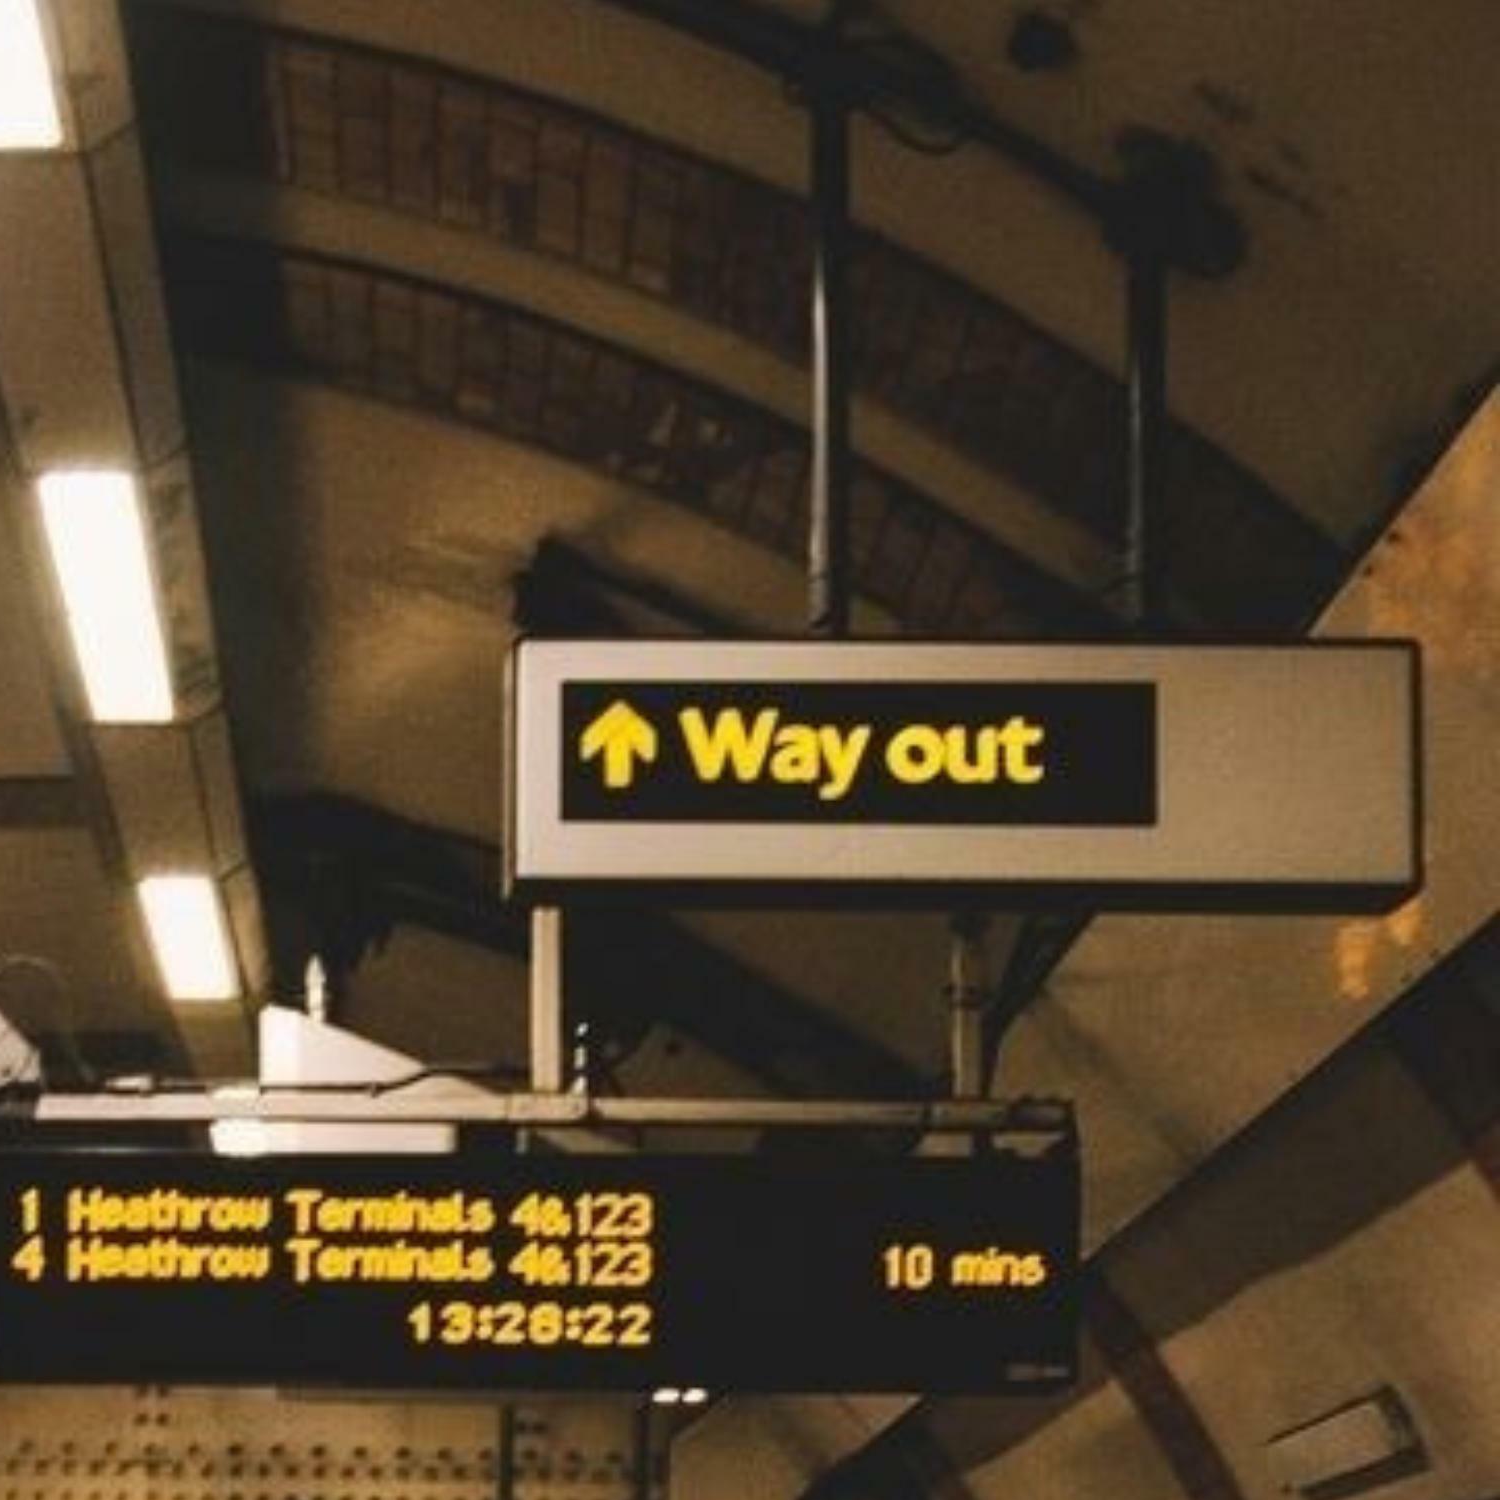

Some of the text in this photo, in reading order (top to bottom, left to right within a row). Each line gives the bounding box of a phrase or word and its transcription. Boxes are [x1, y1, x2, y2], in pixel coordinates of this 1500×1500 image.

[678, 707, 1045, 800] Way out
[21, 1187, 40, 1233] 1
[66, 1187, 273, 1233] Heathrow
[284, 1188, 496, 1234] Terminals
[11, 1235, 46, 1281] 4
[66, 1236, 272, 1281] Heathrow
[285, 1237, 496, 1283] Terminals
[884, 1244, 935, 1290] 10
[951, 1246, 1047, 1287] mins
